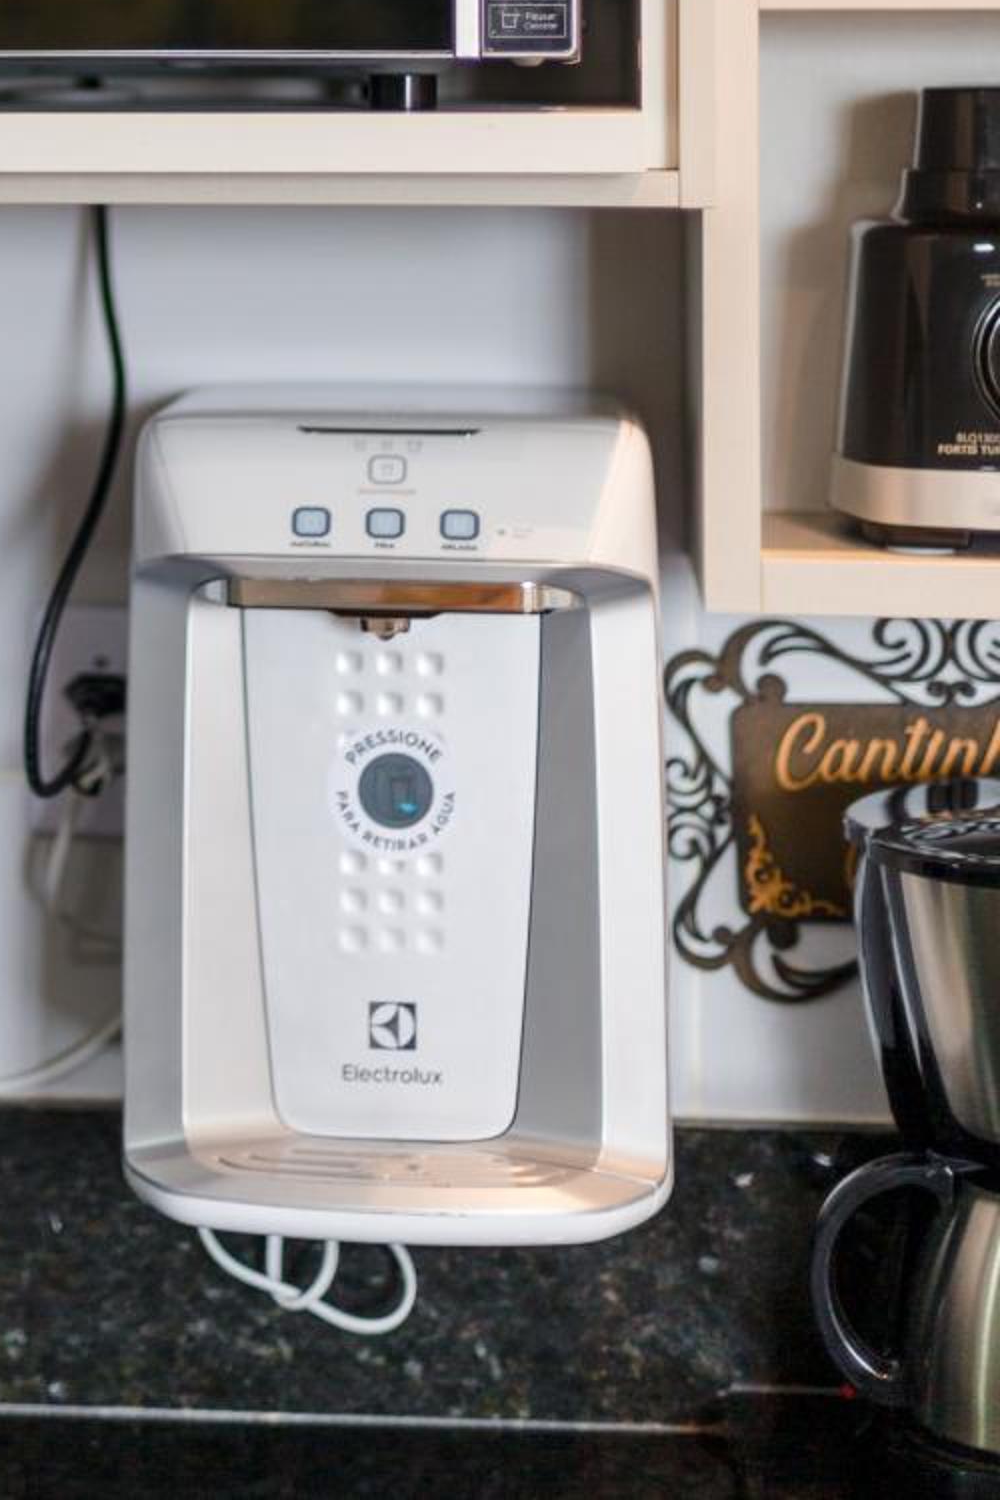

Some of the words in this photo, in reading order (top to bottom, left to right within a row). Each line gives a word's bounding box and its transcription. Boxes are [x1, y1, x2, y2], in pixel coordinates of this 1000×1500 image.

[344, 729, 442, 765] PRESSIONE
[336, 790, 360, 833] PARA
[362, 830, 428, 851] RETIRAR
[341, 1064, 442, 1085] Electrolux
